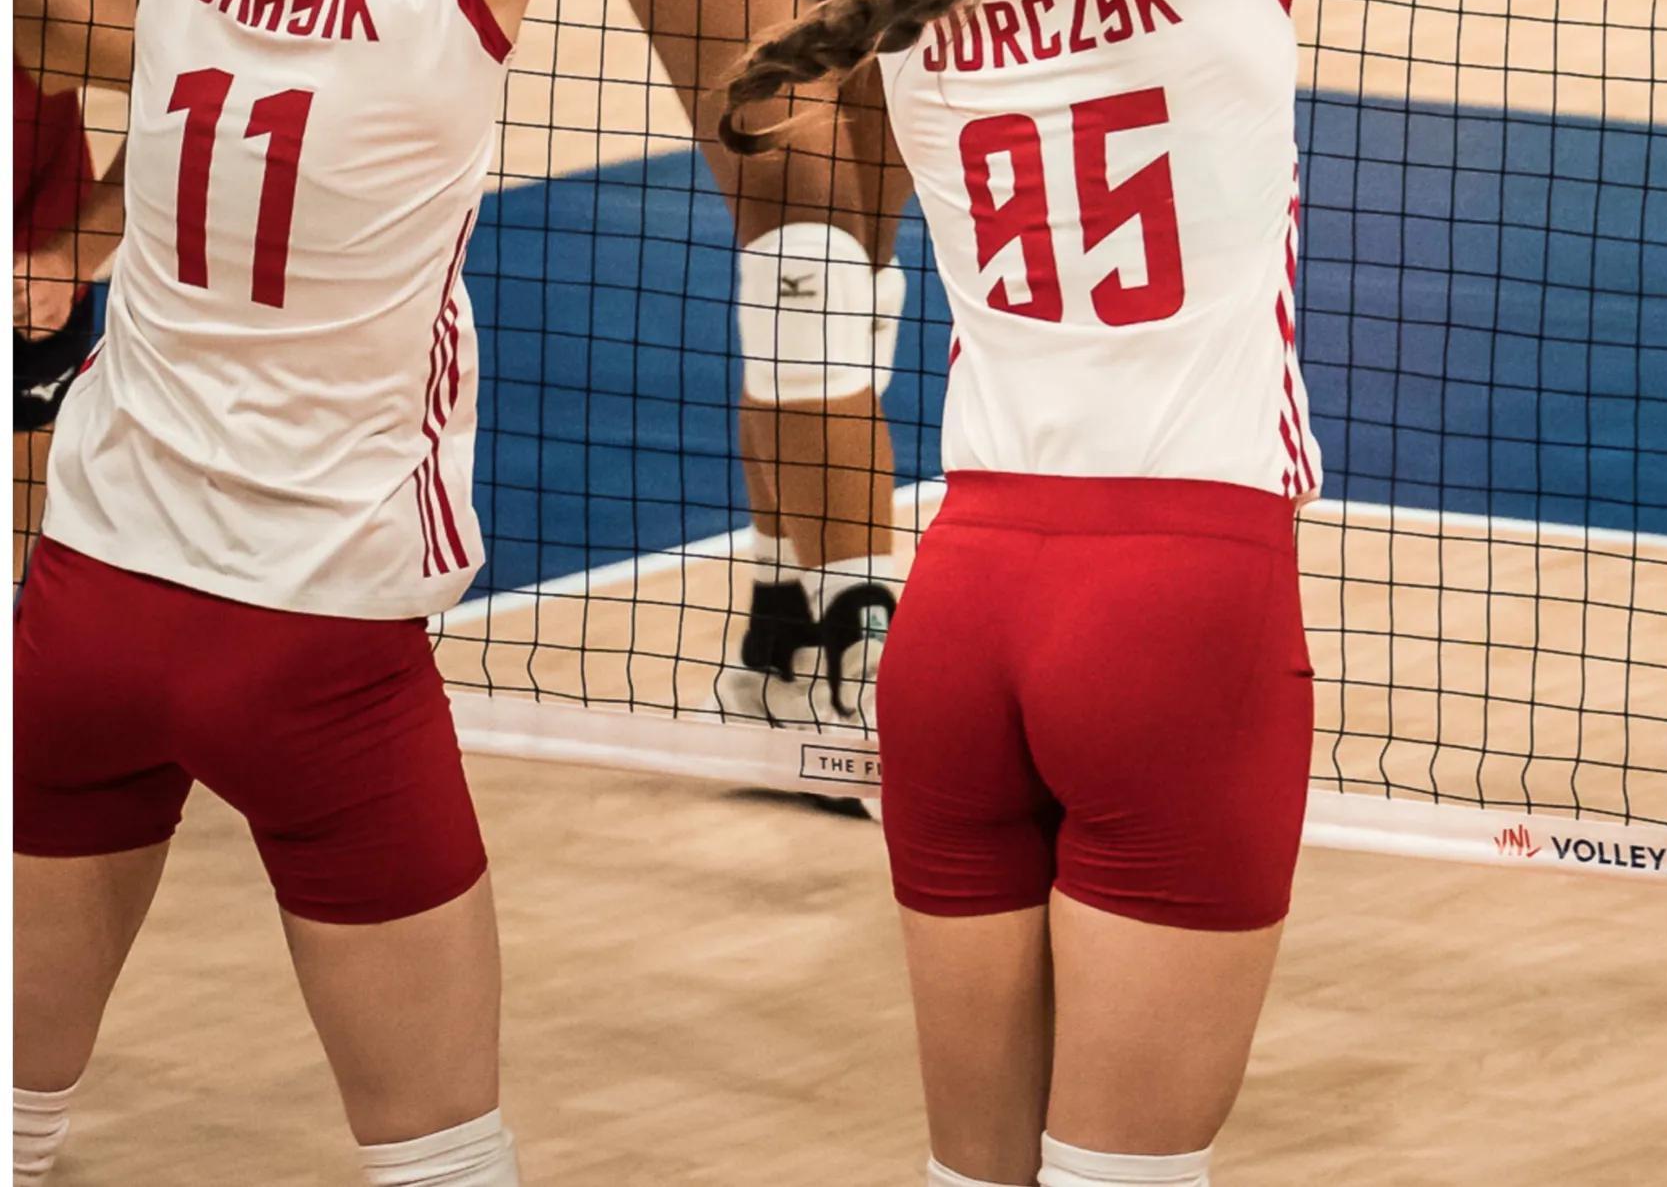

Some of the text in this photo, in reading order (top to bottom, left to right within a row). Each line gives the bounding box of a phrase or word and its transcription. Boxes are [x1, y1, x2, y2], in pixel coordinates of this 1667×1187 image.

[167, 67, 314, 309] 11
[958, 86, 1185, 327] 95
[819, 756, 855, 773] THE
